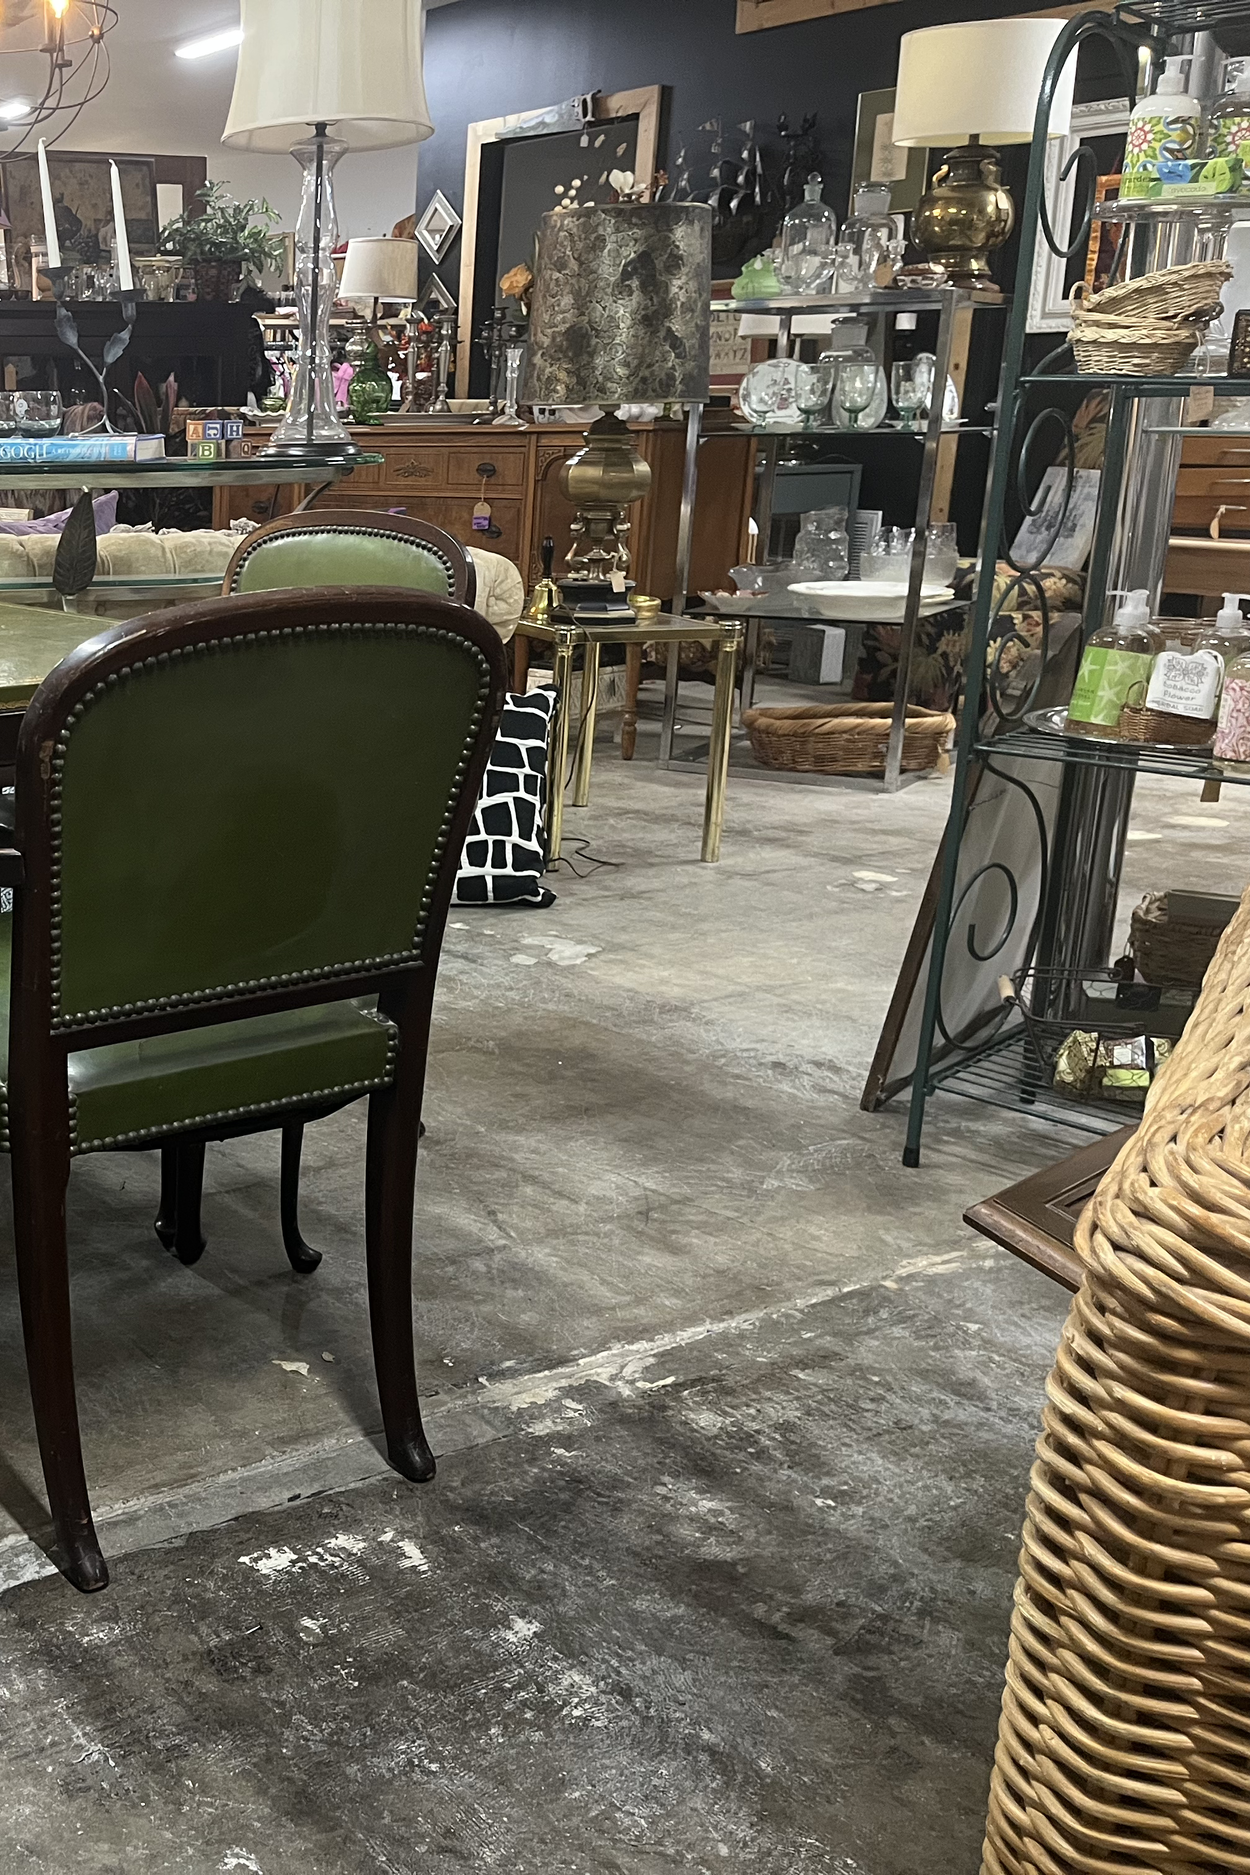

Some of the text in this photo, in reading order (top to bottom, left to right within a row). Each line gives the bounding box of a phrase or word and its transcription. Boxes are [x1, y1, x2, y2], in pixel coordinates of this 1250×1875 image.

[190, 425, 201, 438] A
[228, 424, 241, 437] H
[200, 443, 250, 457] B Q
